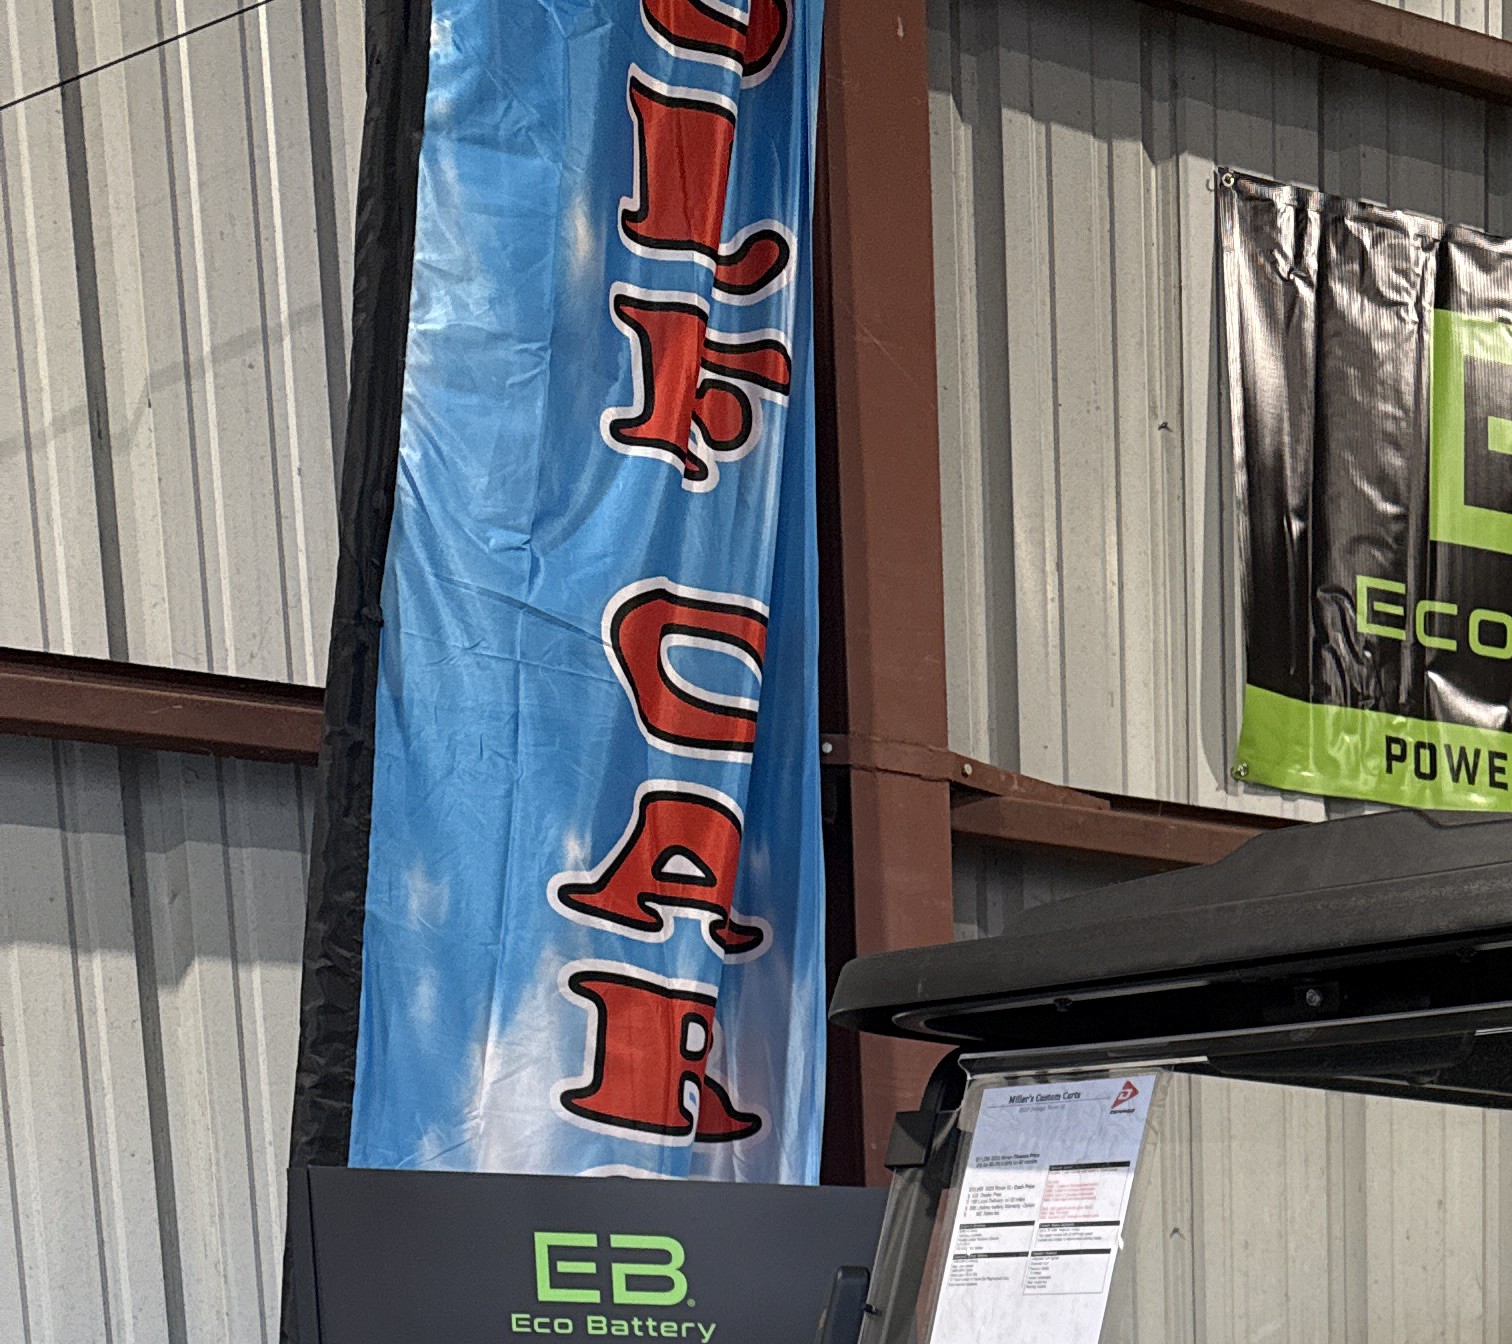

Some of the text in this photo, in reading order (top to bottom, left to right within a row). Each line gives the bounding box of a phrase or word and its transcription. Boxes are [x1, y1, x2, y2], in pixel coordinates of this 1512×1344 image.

[533, 1231, 687, 1306] EB
[511, 1313, 717, 1344] Eco Battery
